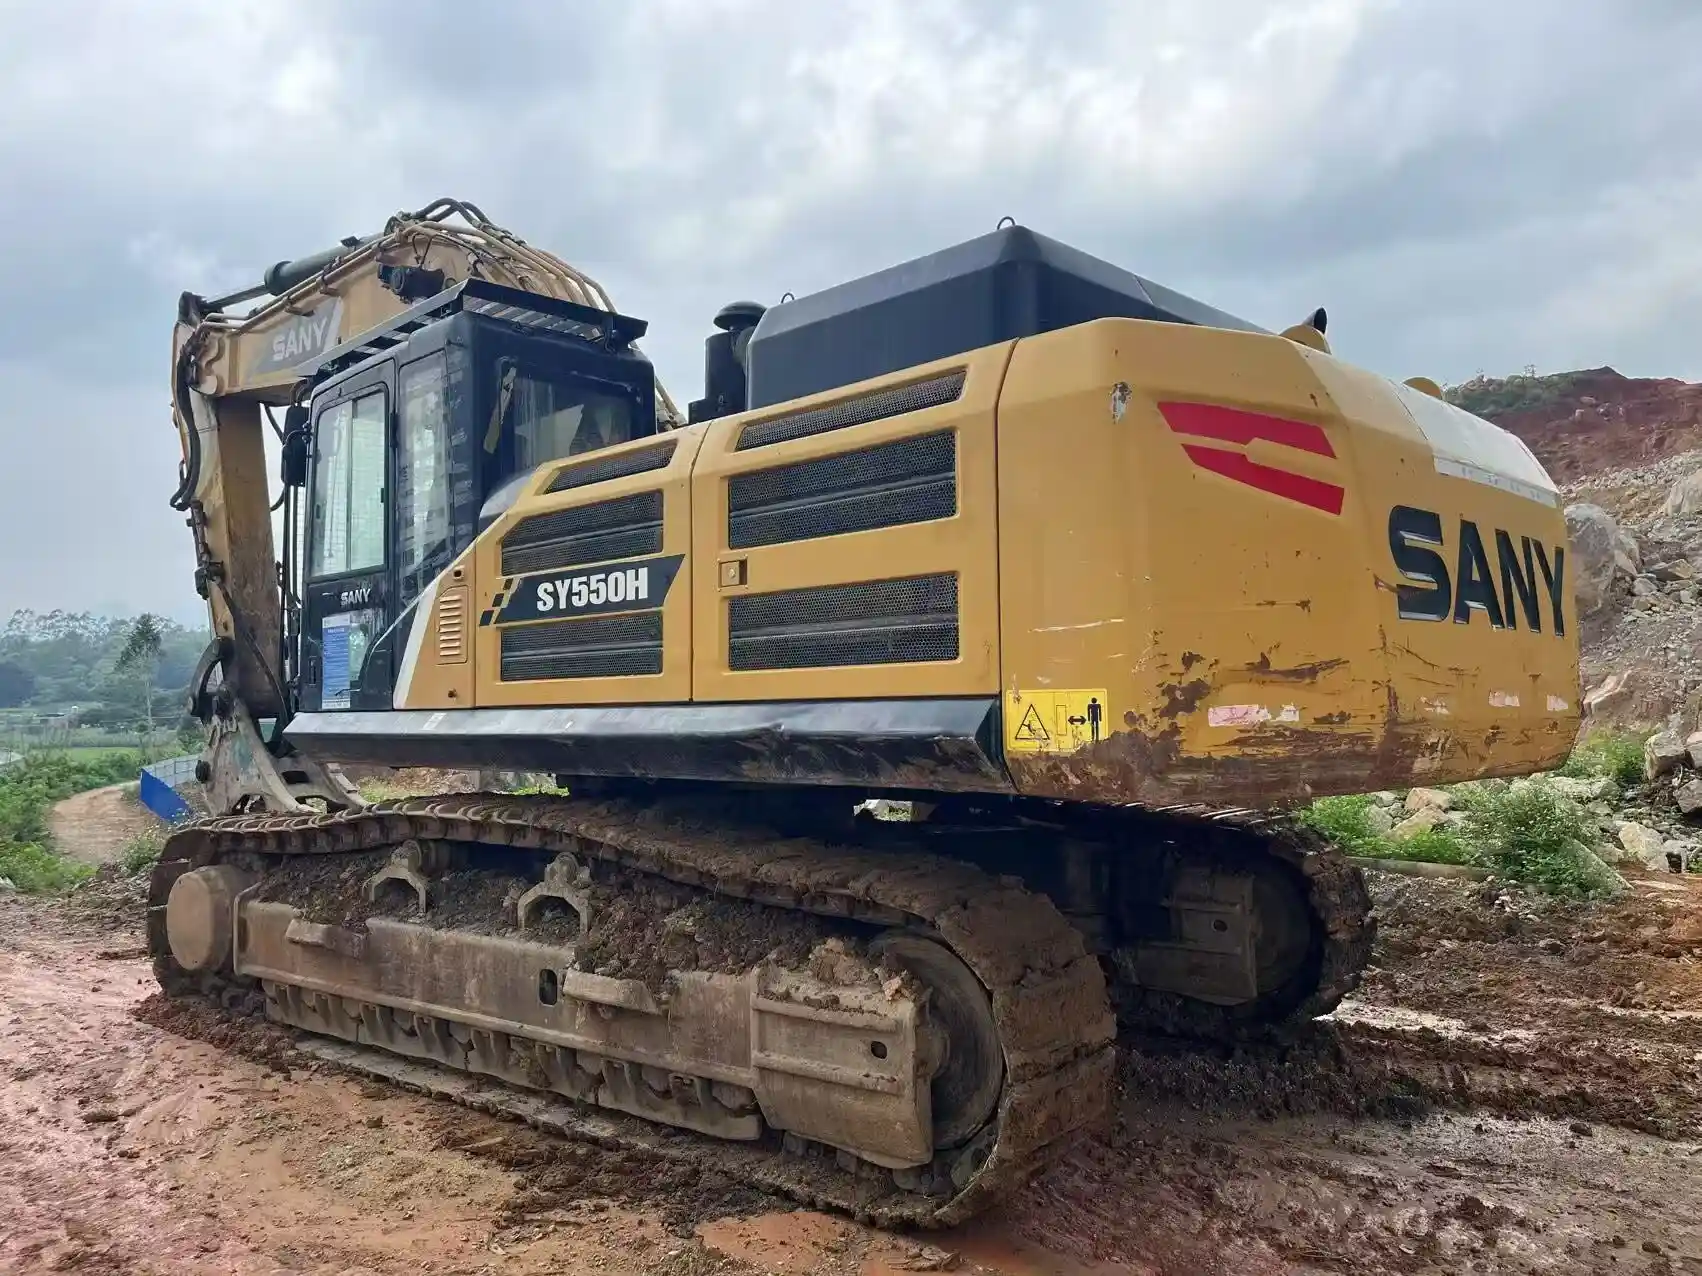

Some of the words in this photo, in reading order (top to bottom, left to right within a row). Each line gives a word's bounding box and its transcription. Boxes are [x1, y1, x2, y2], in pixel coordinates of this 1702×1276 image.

[272, 316, 328, 361] SANY
[536, 567, 649, 612] SY550H
[1388, 504, 1565, 636] SANY
[340, 588, 371, 606] SANY
